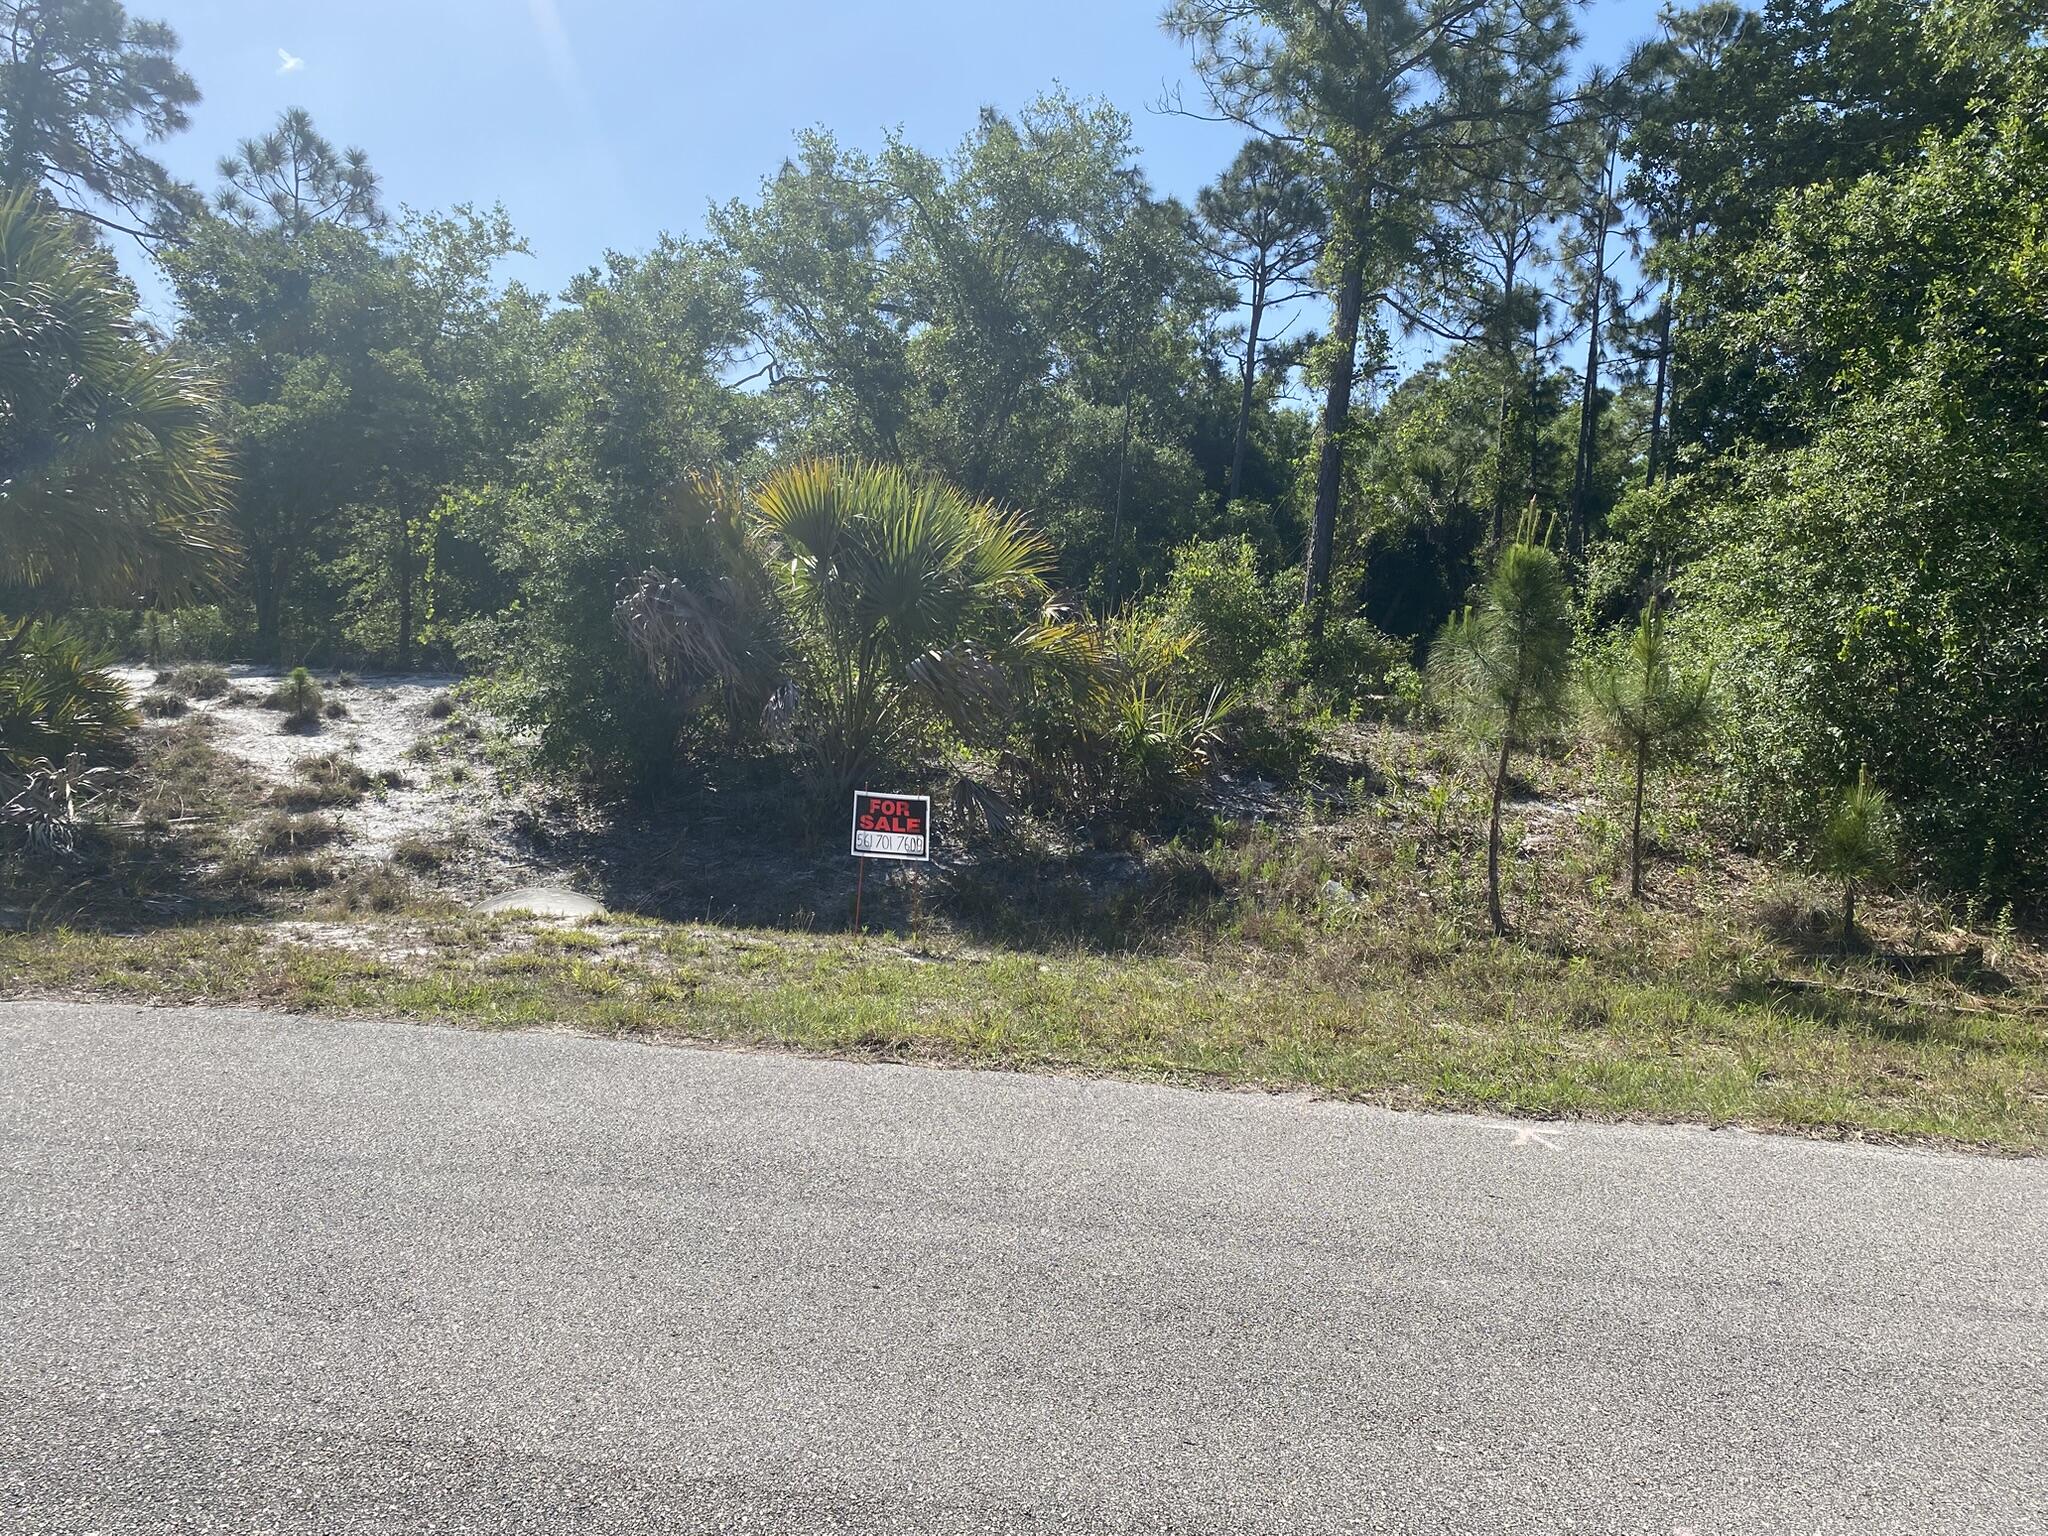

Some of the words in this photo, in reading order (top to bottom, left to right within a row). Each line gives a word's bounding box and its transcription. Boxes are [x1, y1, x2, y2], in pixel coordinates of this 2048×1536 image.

[869, 799, 910, 817] FOR
[860, 815, 920, 832] SALE
[875, 834, 892, 850] 701
